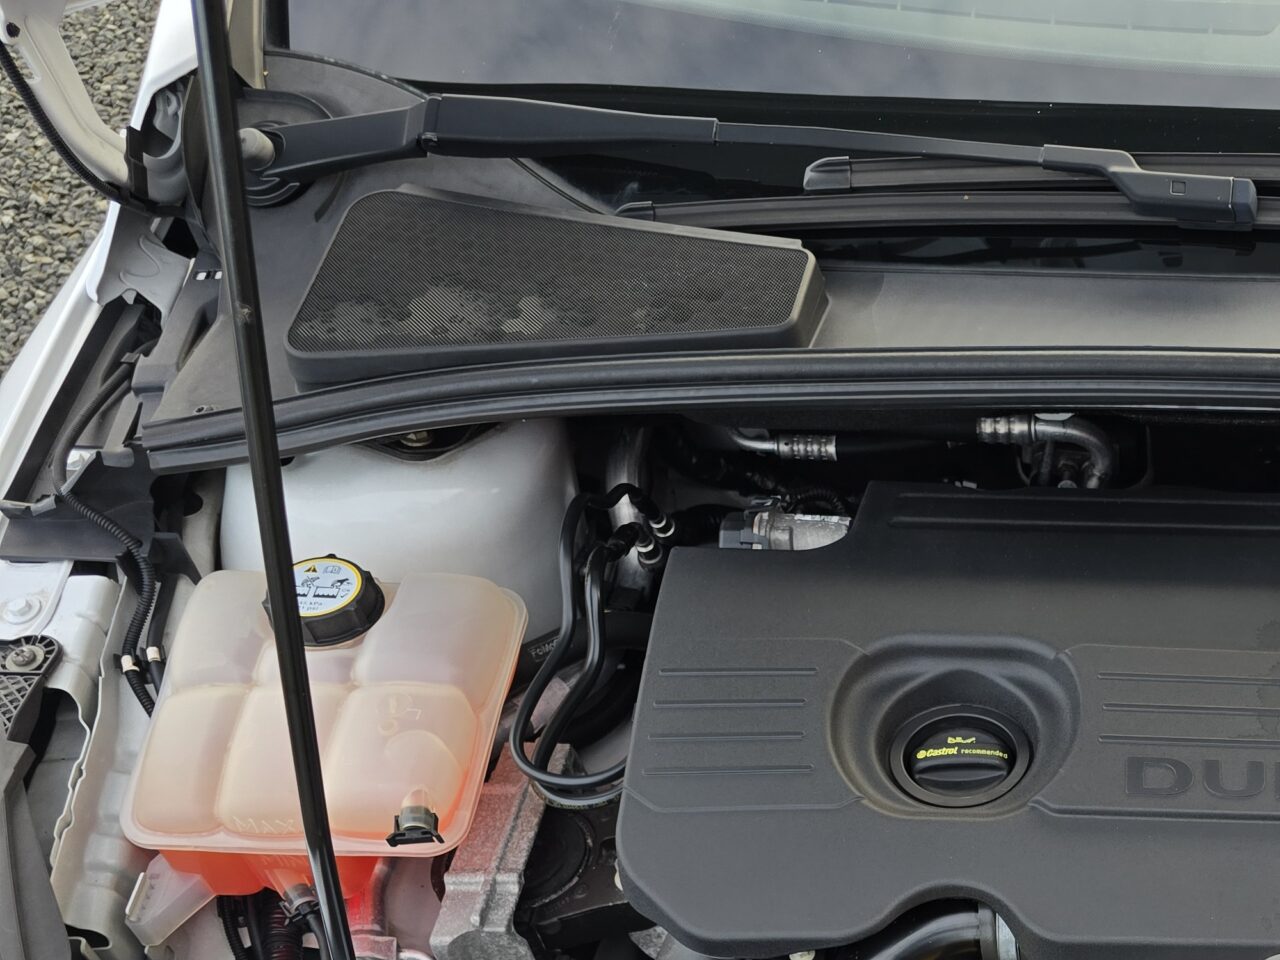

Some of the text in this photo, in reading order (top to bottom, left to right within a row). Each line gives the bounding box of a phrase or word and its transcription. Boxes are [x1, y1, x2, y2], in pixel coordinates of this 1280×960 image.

[926, 746, 1008, 759] Castrol recommended
[232, 815, 298, 834] MAX
